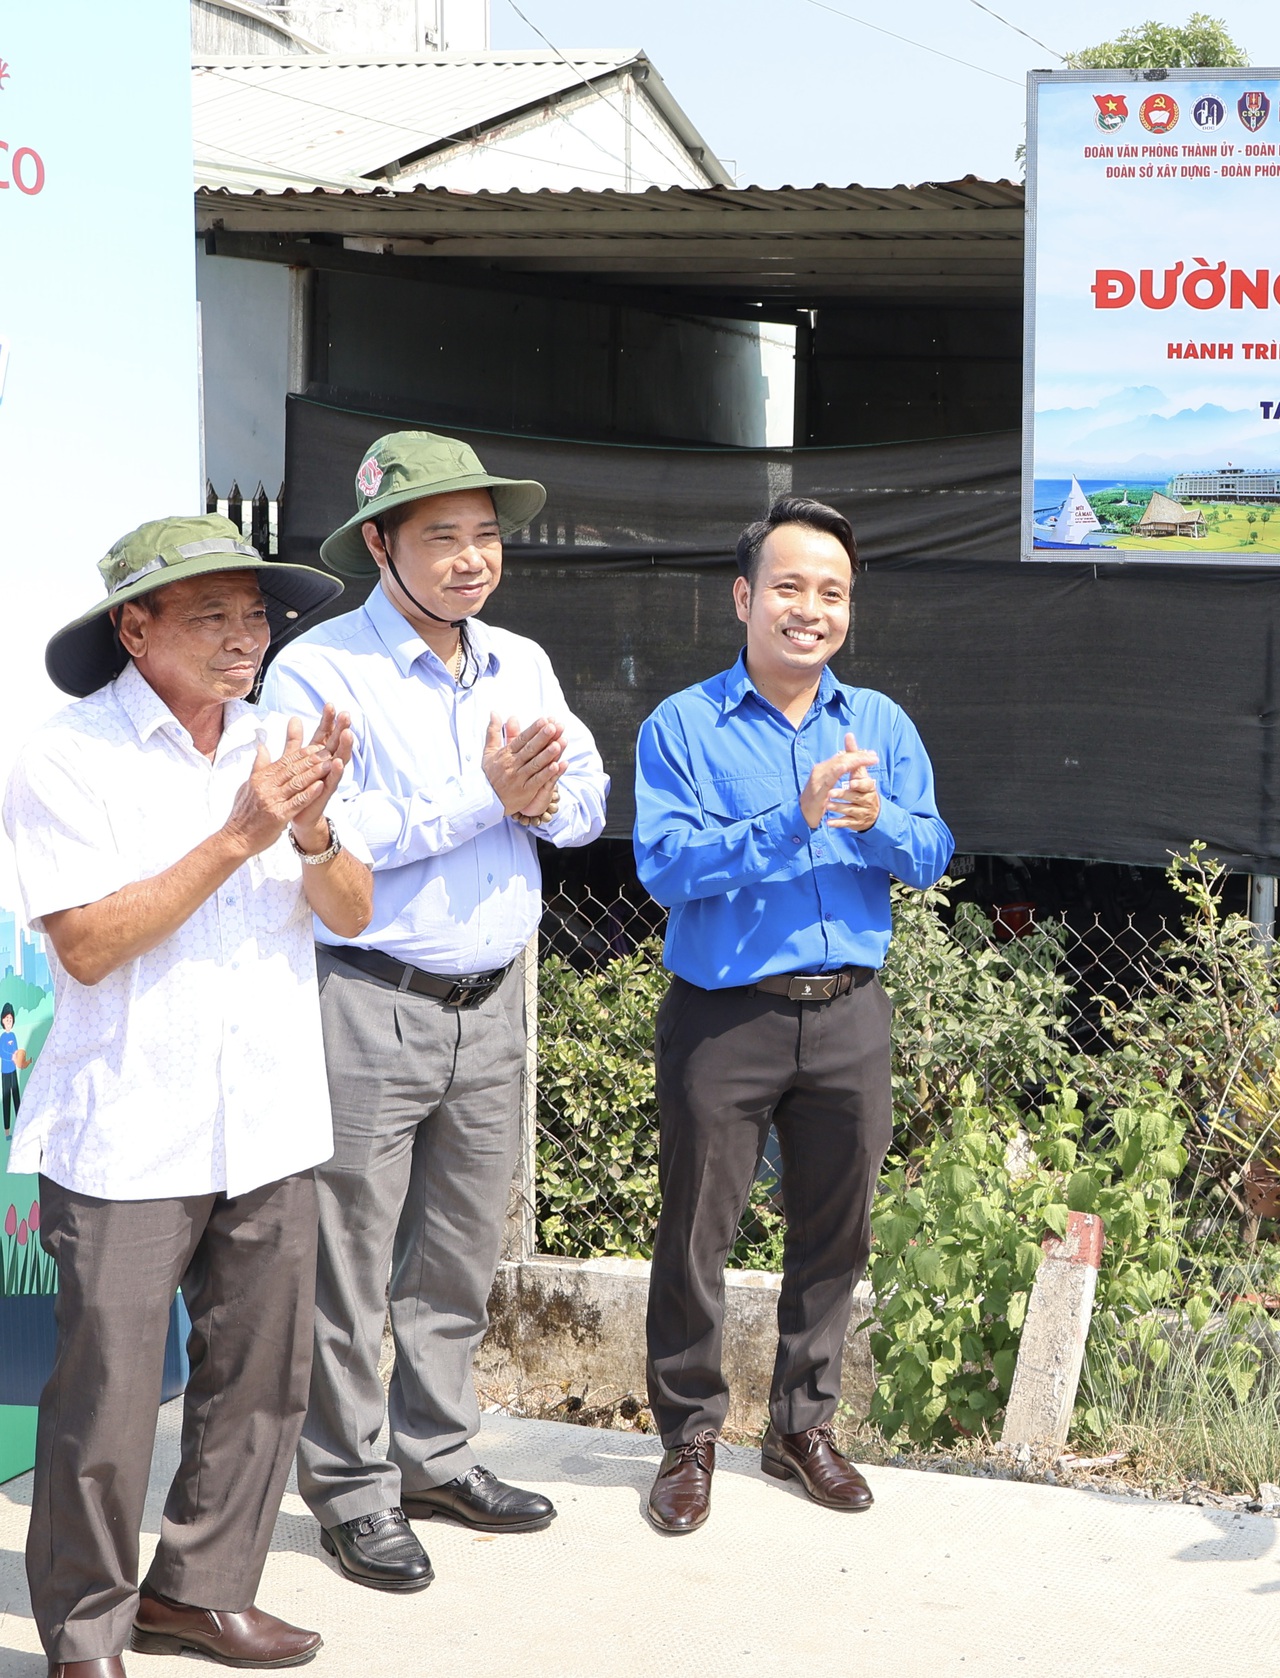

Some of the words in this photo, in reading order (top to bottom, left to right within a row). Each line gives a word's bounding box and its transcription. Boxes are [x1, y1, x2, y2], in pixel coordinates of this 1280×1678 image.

[1084, 144, 1114, 158] ĐOÀN
[1116, 143, 1138, 158] VĂN
[1141, 143, 1178, 158] PHÒNG
[1181, 143, 1217, 157] THÀNH
[1220, 141, 1235, 157] ỦY
[1245, 143, 1275, 157] ĐOÀN
[1106, 163, 1136, 178] ĐOÀN
[1139, 162, 1154, 178] SỞ
[1157, 163, 1177, 177] XÂY
[1180, 164, 1210, 180] DỰNG
[1221, 162, 1251, 177] ĐOÀN
[1167, 339, 1233, 360] HÀNH
